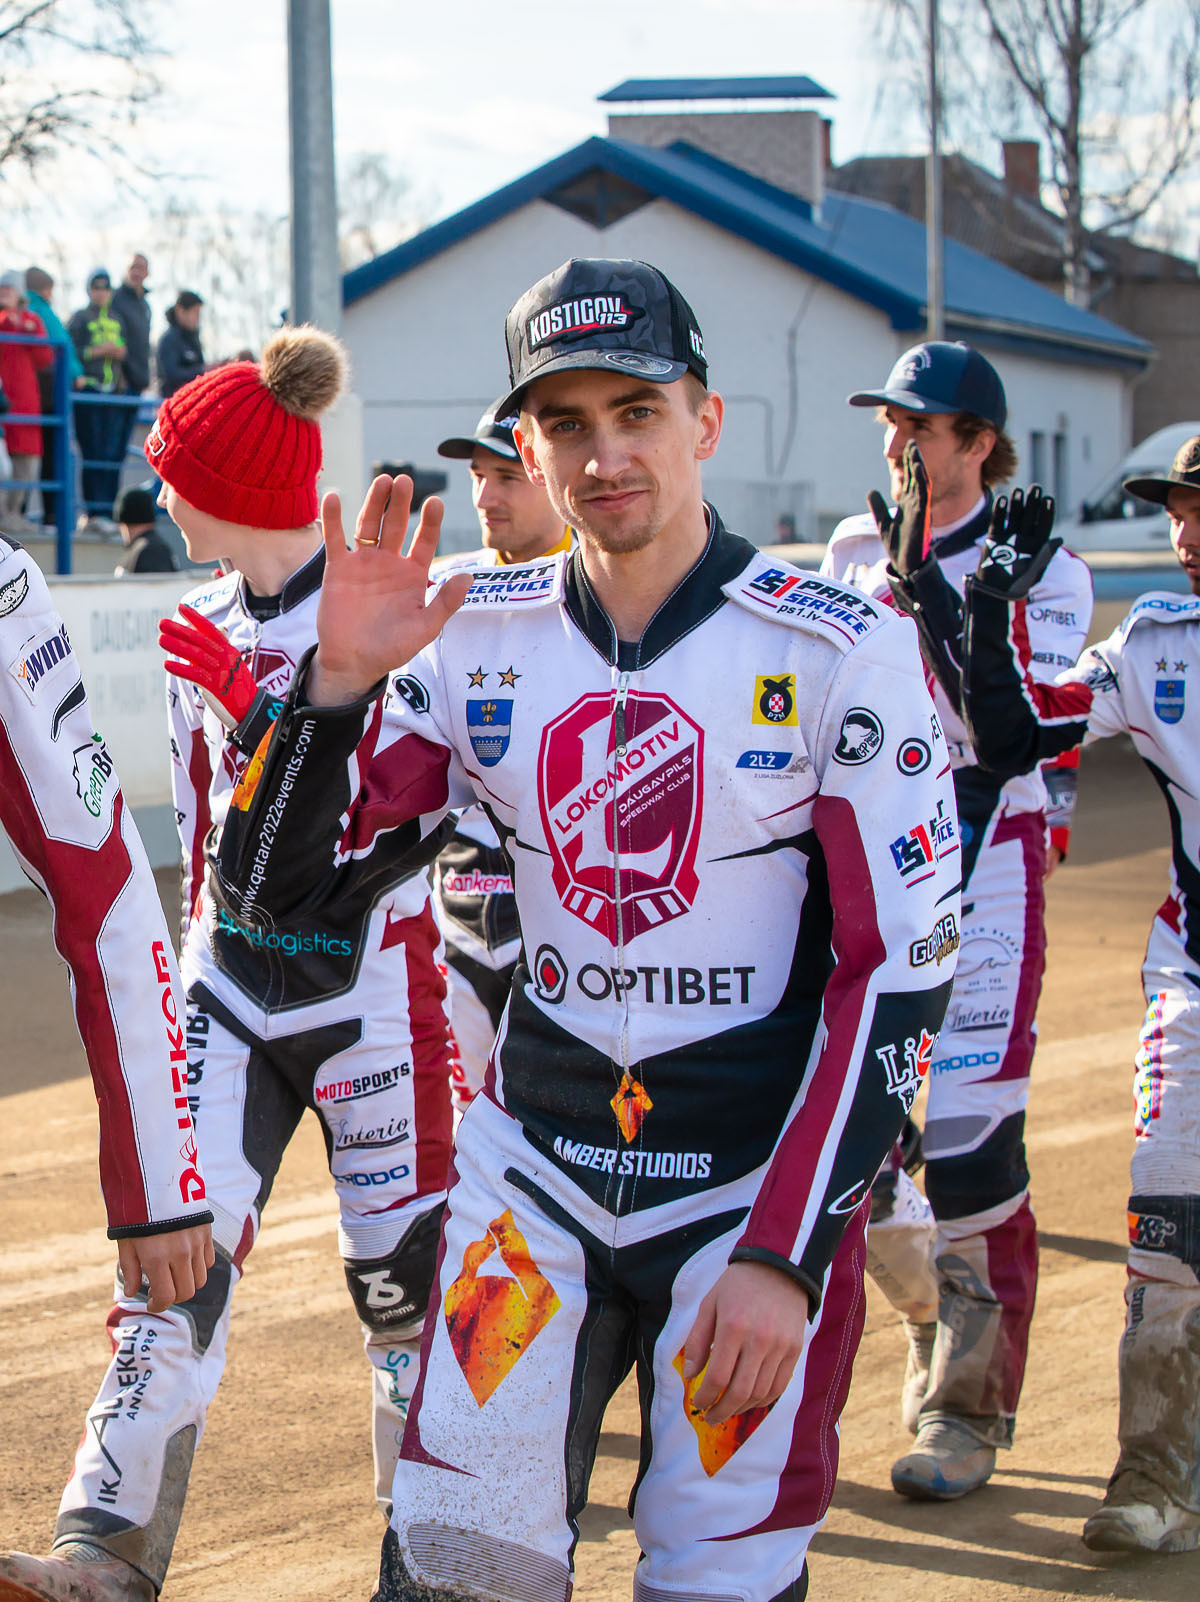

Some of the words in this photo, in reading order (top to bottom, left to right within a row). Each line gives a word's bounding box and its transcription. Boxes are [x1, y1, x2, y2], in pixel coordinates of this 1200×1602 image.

[598, 312, 629, 326] 113
[467, 579, 555, 595] SERVICE
[473, 563, 557, 582] PART
[776, 604, 823, 622] ps1.lv
[784, 592, 868, 636] SERVICE
[797, 580, 879, 620] PART
[1030, 607, 1076, 627] OPTIBET
[554, 720, 680, 834] LOKOMOTIV
[749, 752, 776, 768] 2LŻ
[618, 755, 693, 814] DAUGAVPILS
[619, 790, 666, 828] SPEEDWAY
[666, 772, 691, 792] CLUB
[238, 718, 317, 922] www.qatar2022events.com
[576, 966, 756, 1005] OPTIBET
[316, 1062, 410, 1101] MOTOSPORTS
[931, 1051, 1000, 1077] TRODO
[553, 1136, 615, 1174] AMBER
[618, 1151, 713, 1179] STUDIOS
[374, 1303, 416, 1322] Systems
[126, 1369, 152, 1421] ANNO
[141, 1328, 158, 1361] 1989
[97, 1478, 123, 1505] IK
